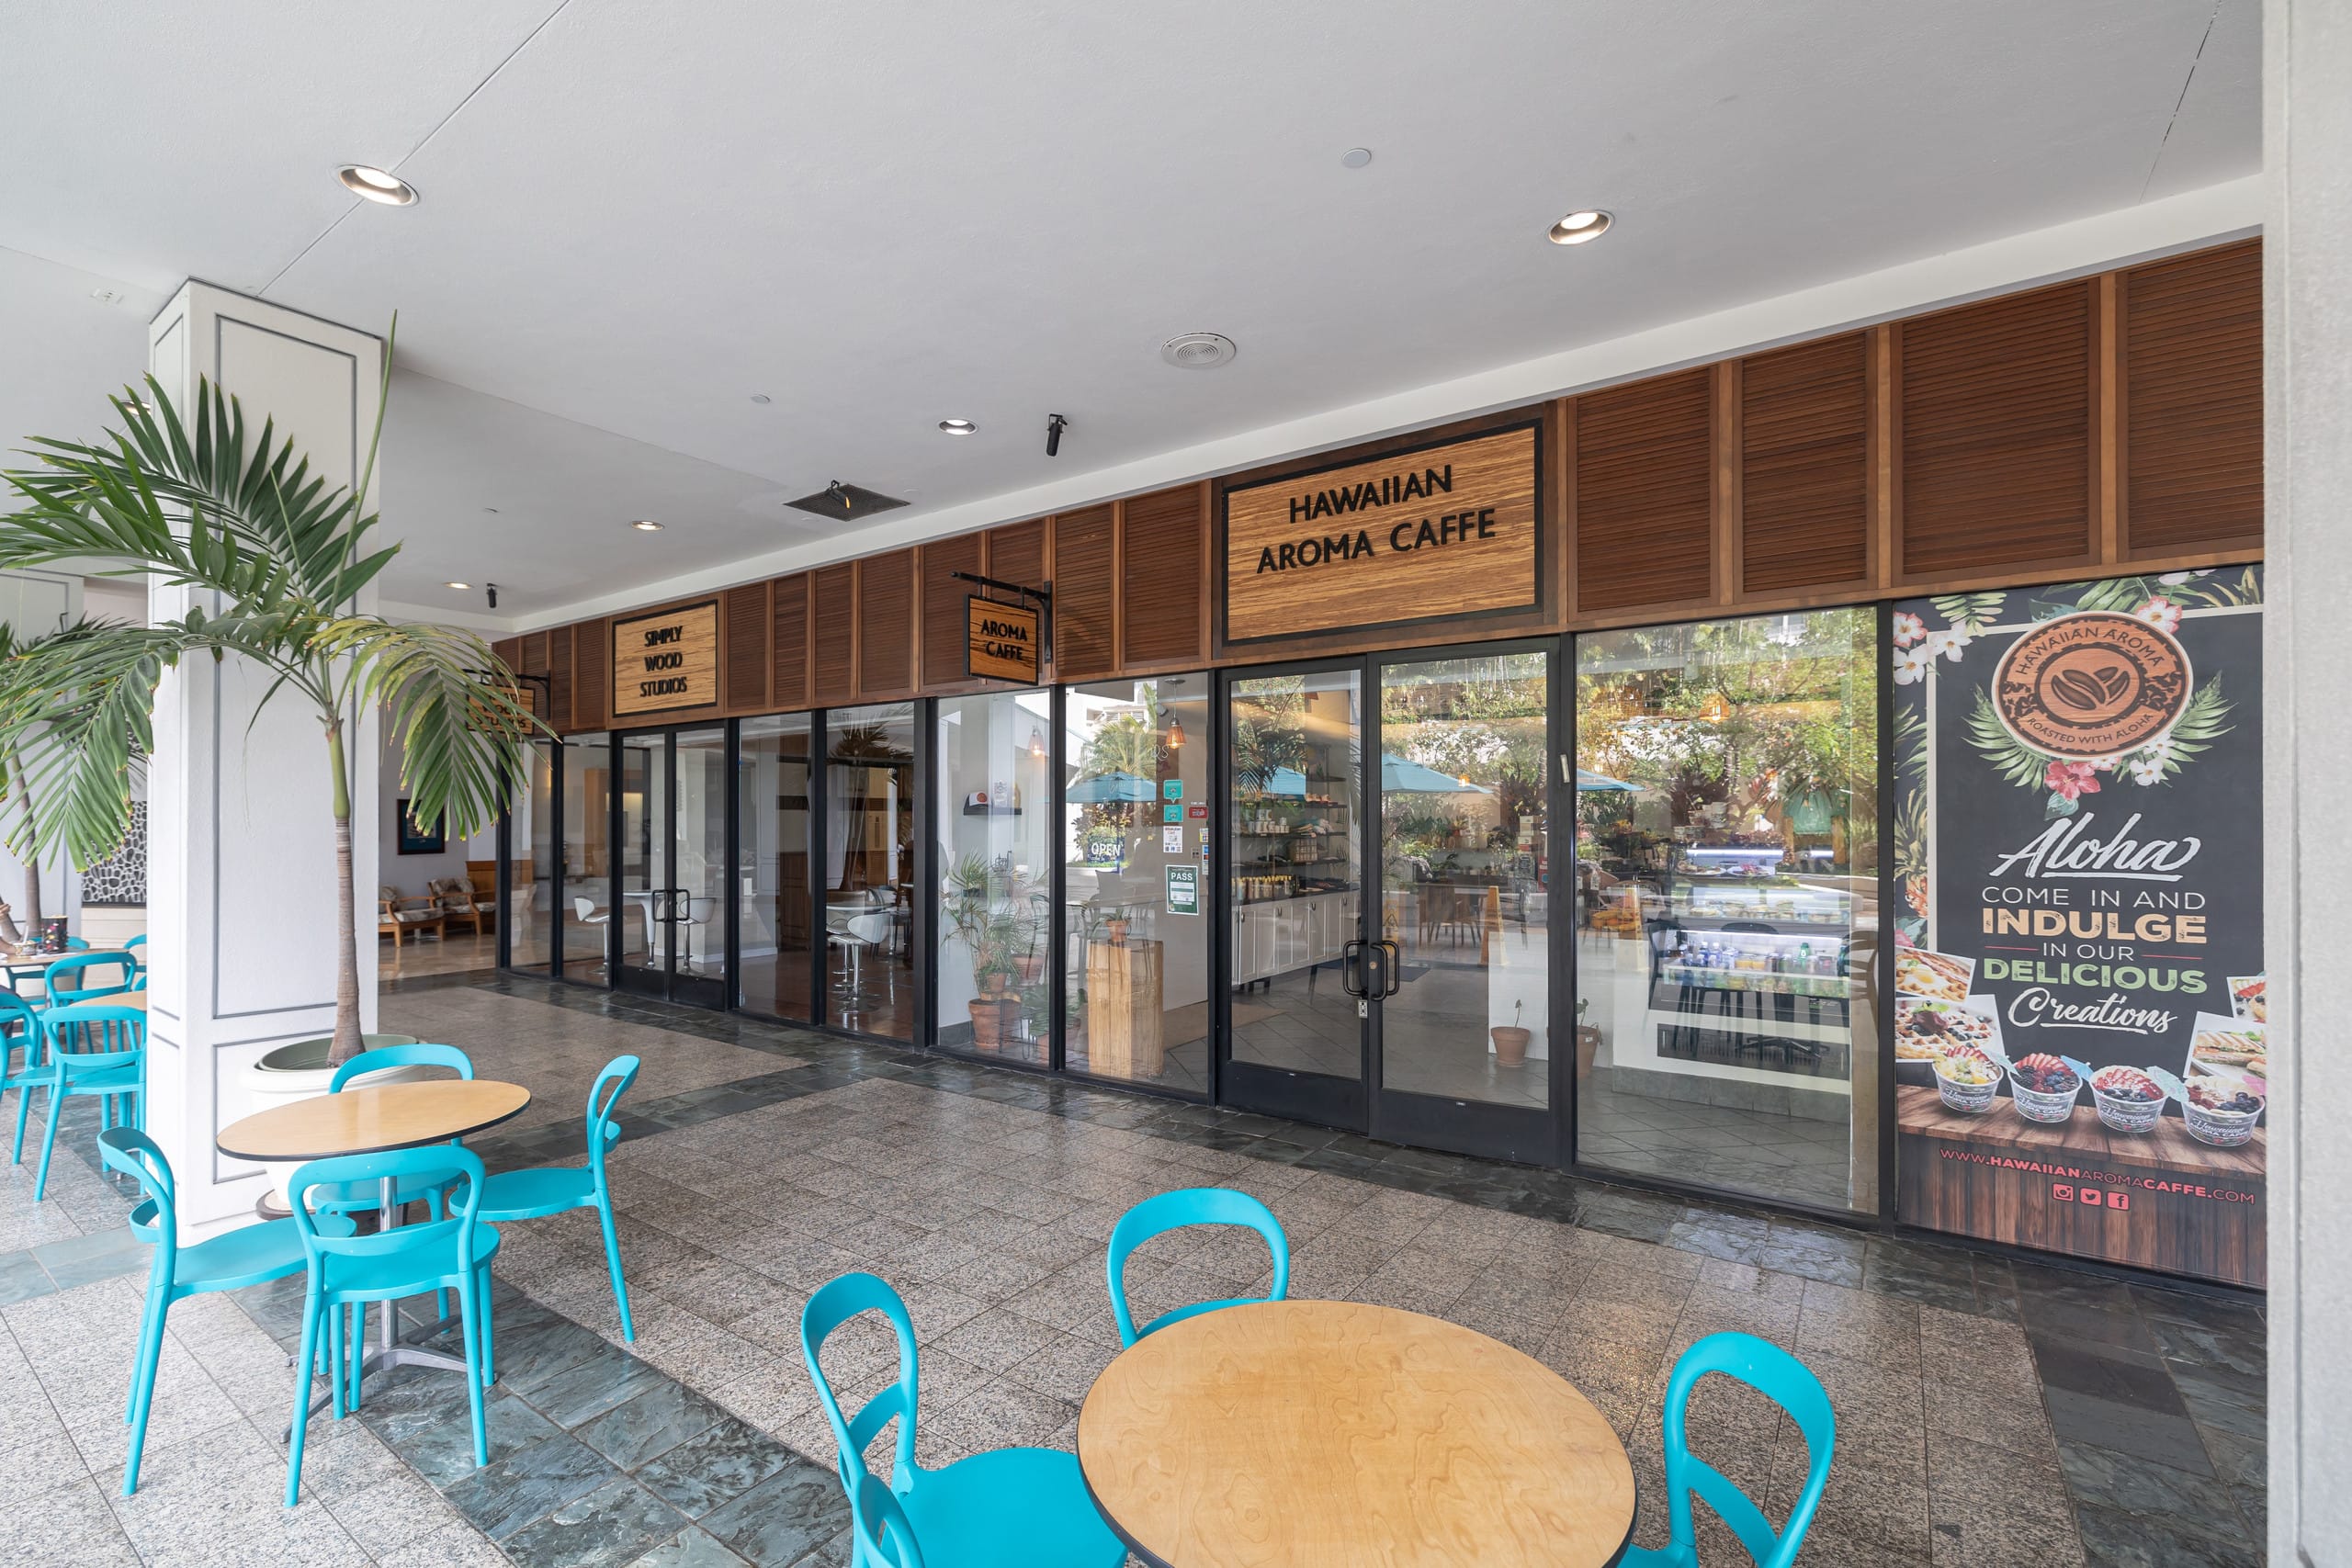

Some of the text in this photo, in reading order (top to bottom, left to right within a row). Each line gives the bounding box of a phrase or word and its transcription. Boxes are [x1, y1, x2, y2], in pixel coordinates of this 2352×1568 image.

[1289, 464, 1453, 525] HAWAIIAN
[1256, 508, 1497, 574] AROMA CAFFE
[644, 626, 683, 648] SIMPLY
[980, 618, 1028, 642] AROMA
[644, 651, 683, 672] WOOD
[985, 641, 1023, 660] CAFFE
[2016, 626, 2165, 676] HAWAIIAN AROMA
[639, 676, 687, 698] STUDIOS
[2026, 712, 2154, 745] ROASTED WITH ALOHA
[1091, 841, 1121, 857] OPEN
[1989, 811, 2202, 879] Aloha
[1170, 872, 1193, 881] PASS
[1981, 886, 2206, 910] COME IN AND
[1982, 907, 2208, 944] INDULGE
[2043, 942, 2134, 962] IN OUR
[1983, 957, 2208, 995] DELICIOUS
[2007, 987, 2178, 1034] Creations
